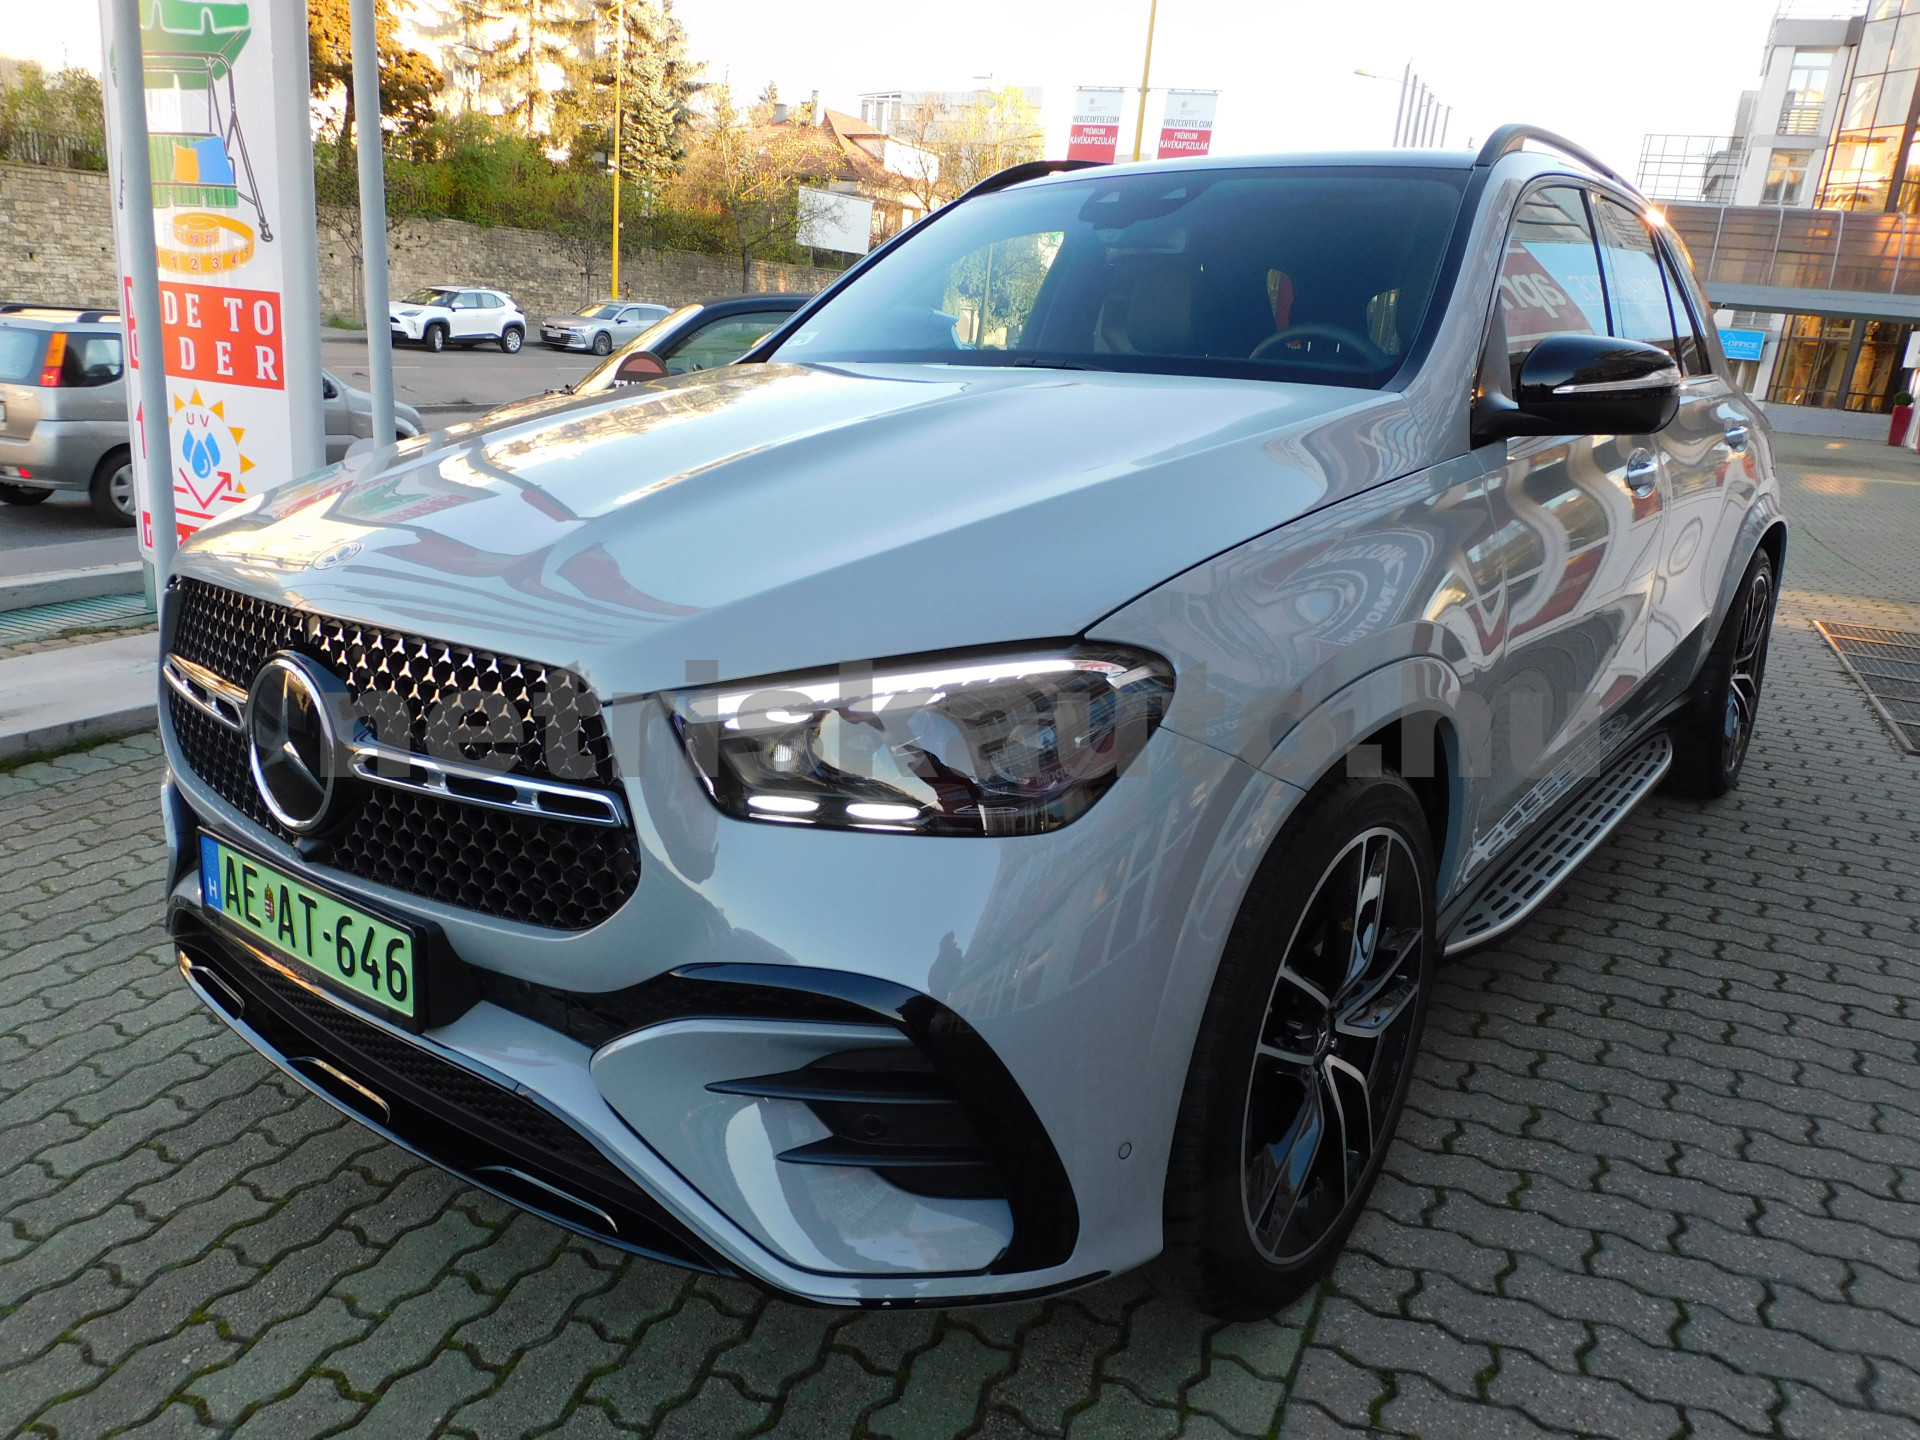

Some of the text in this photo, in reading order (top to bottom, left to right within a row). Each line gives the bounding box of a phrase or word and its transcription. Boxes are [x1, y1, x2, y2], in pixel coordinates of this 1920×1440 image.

[1082, 126, 1106, 135] PRÉMIUM
[1173, 131, 1199, 140] PRÉMIUM
[1069, 134, 1116, 146] KÁVÉKAPSZULÁK
[1159, 138, 1209, 151] KÁVÉKAPSZULÁK
[191, 258, 198, 270] 2
[212, 257, 219, 269] 3
[231, 254, 237, 265] 4
[223, 297, 274, 336] TO
[186, 413, 210, 428] UV
[208, 853, 408, 1002] H AE AT-646
